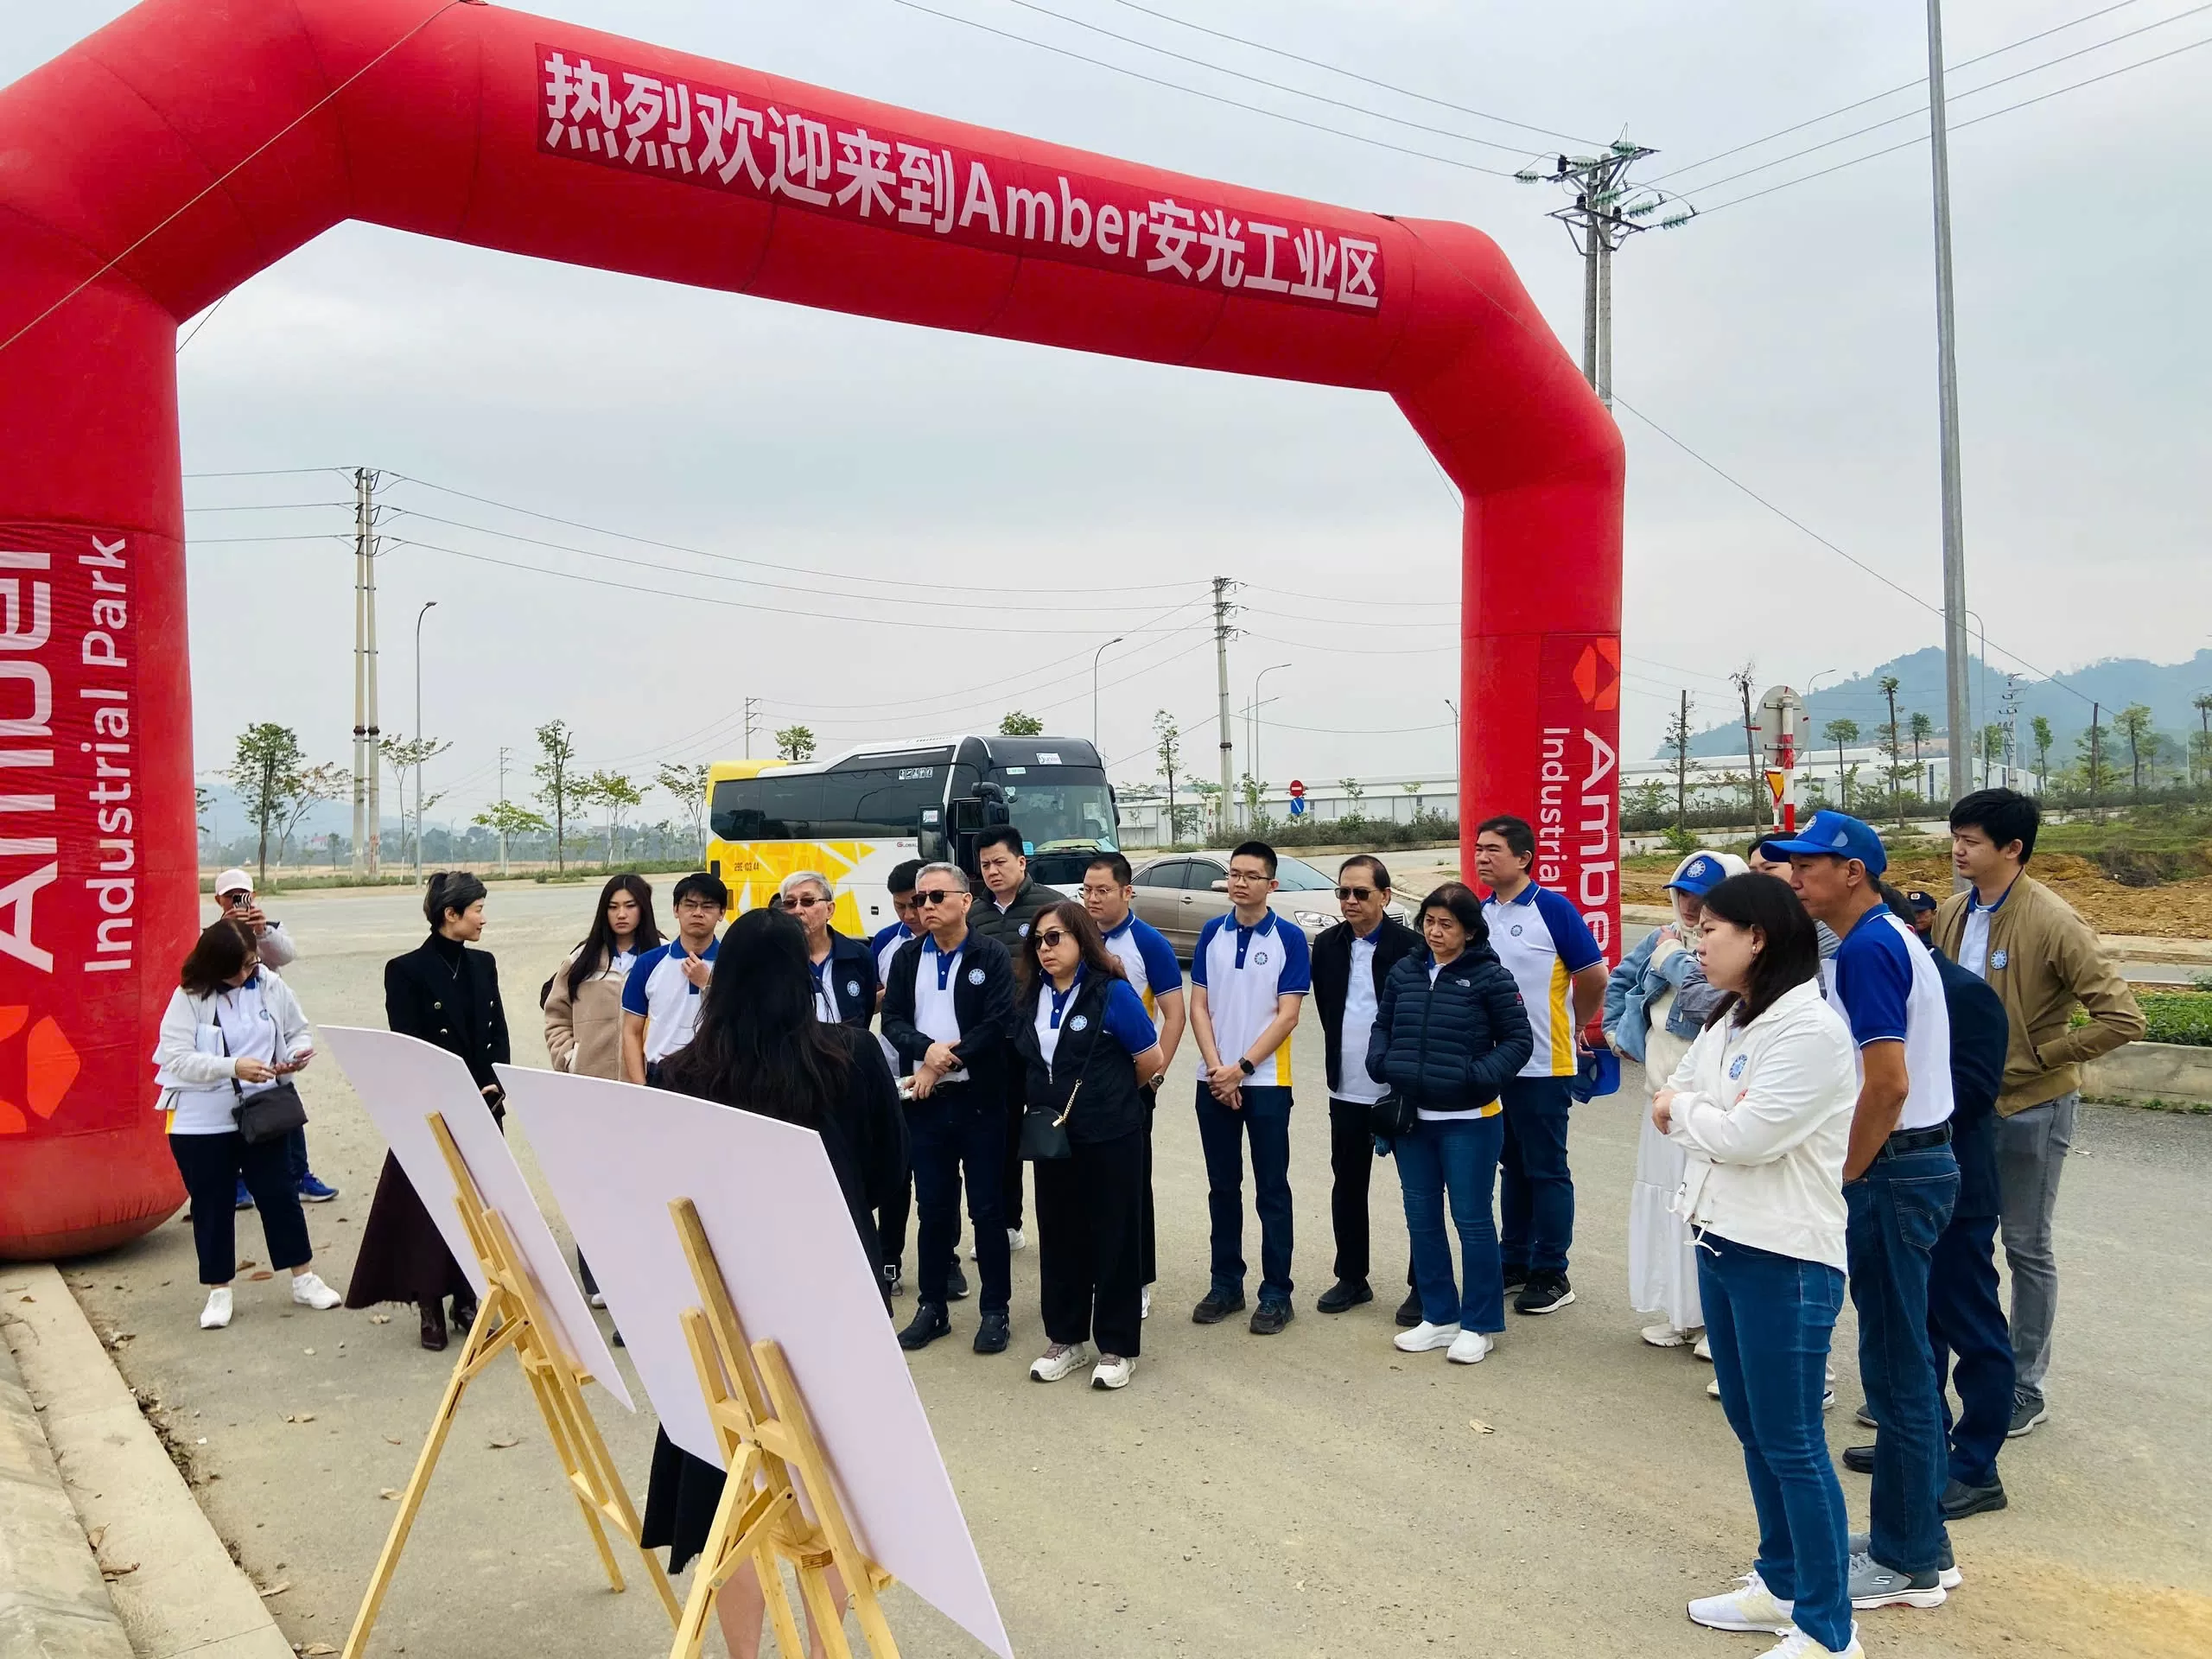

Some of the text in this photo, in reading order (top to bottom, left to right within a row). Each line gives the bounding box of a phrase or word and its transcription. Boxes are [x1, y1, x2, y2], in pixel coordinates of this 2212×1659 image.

[544, 52, 1378, 308] 热烈欢迎来到Amber安光工业区
[79, 535, 135, 972] Industrial Park
[1539, 728, 1570, 893] Industrial
[1580, 728, 1616, 965] Ambe
